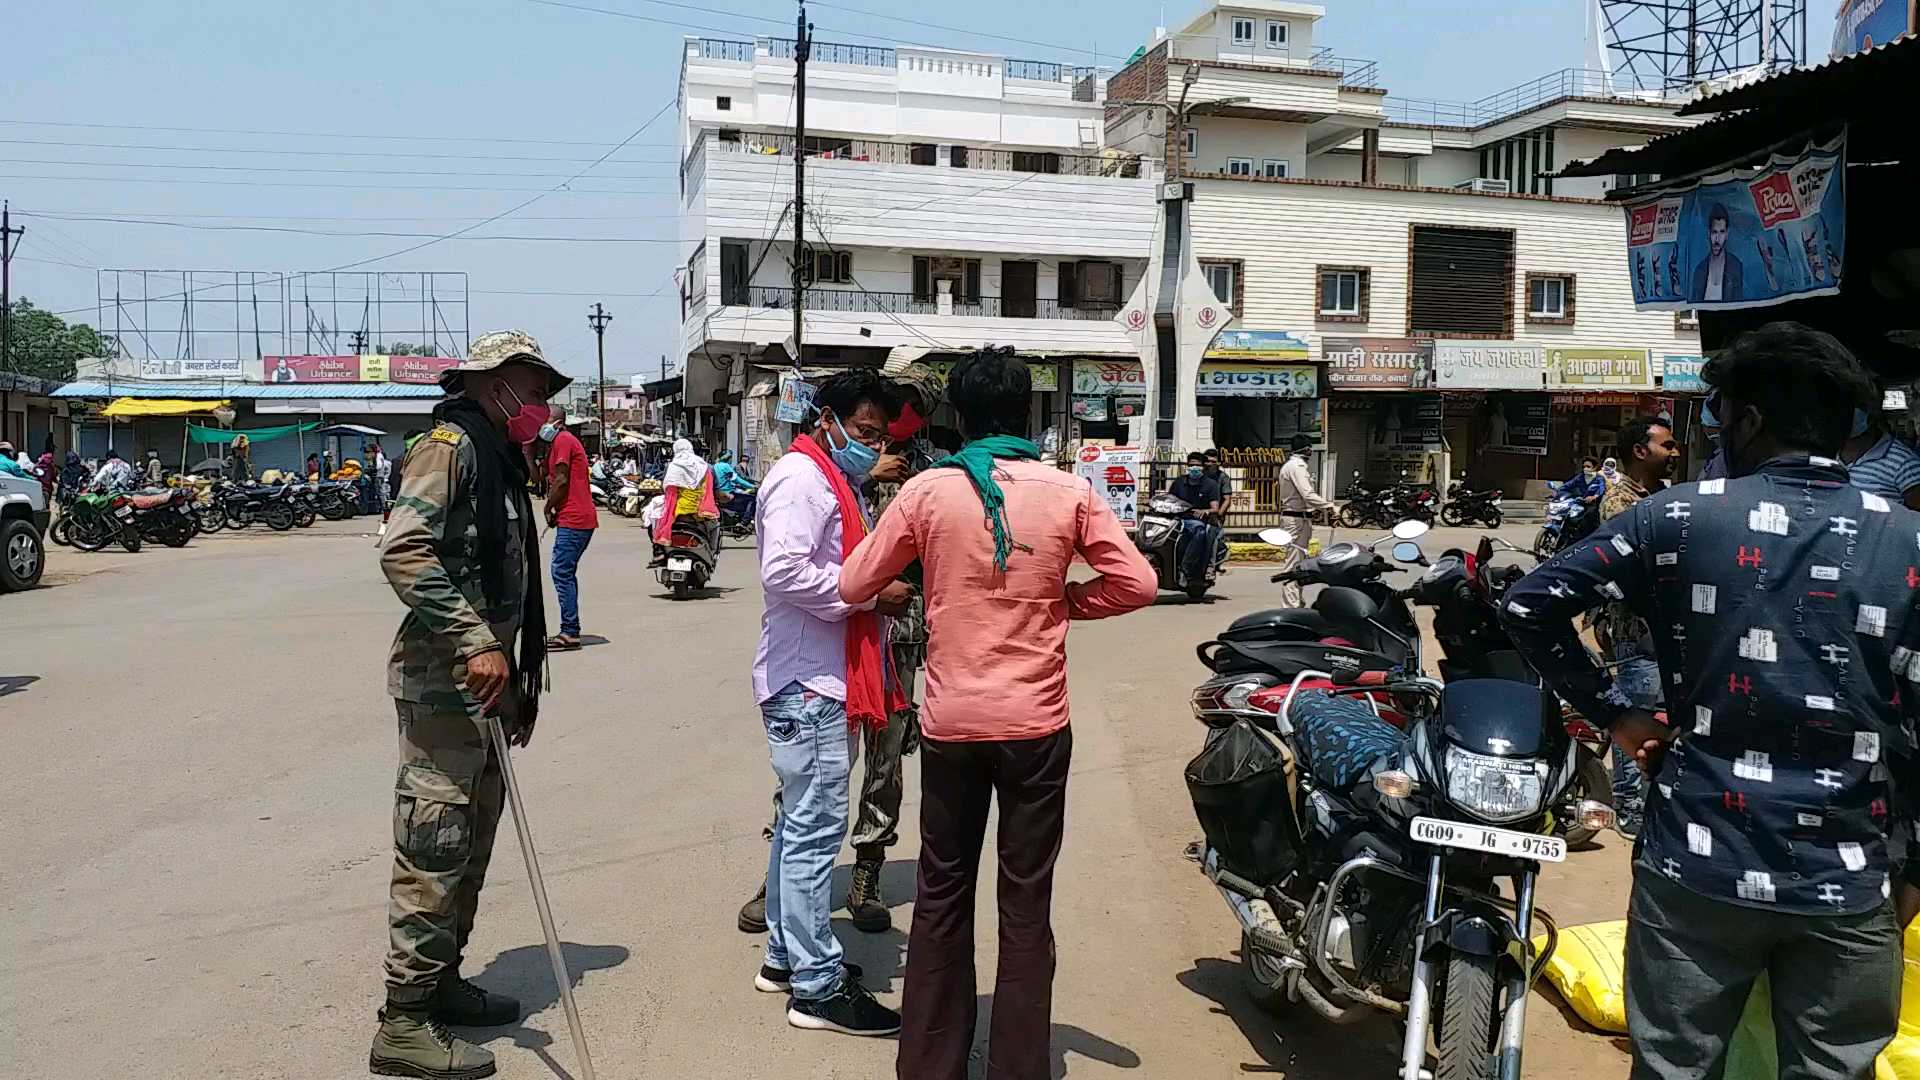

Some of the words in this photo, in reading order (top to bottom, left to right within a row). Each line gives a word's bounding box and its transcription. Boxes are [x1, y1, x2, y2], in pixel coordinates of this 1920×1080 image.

[1371, 346, 1417, 368] संसार
[1460, 350, 1483, 367] जय
[1567, 359, 1612, 375] आकाश
[1615, 355, 1640, 375] गंगा
[1213, 371, 1290, 386] भण्डार
[1417, 822, 1454, 841] CG09
[1480, 831, 1498, 848] JG
[1522, 837, 1562, 857] 9755
